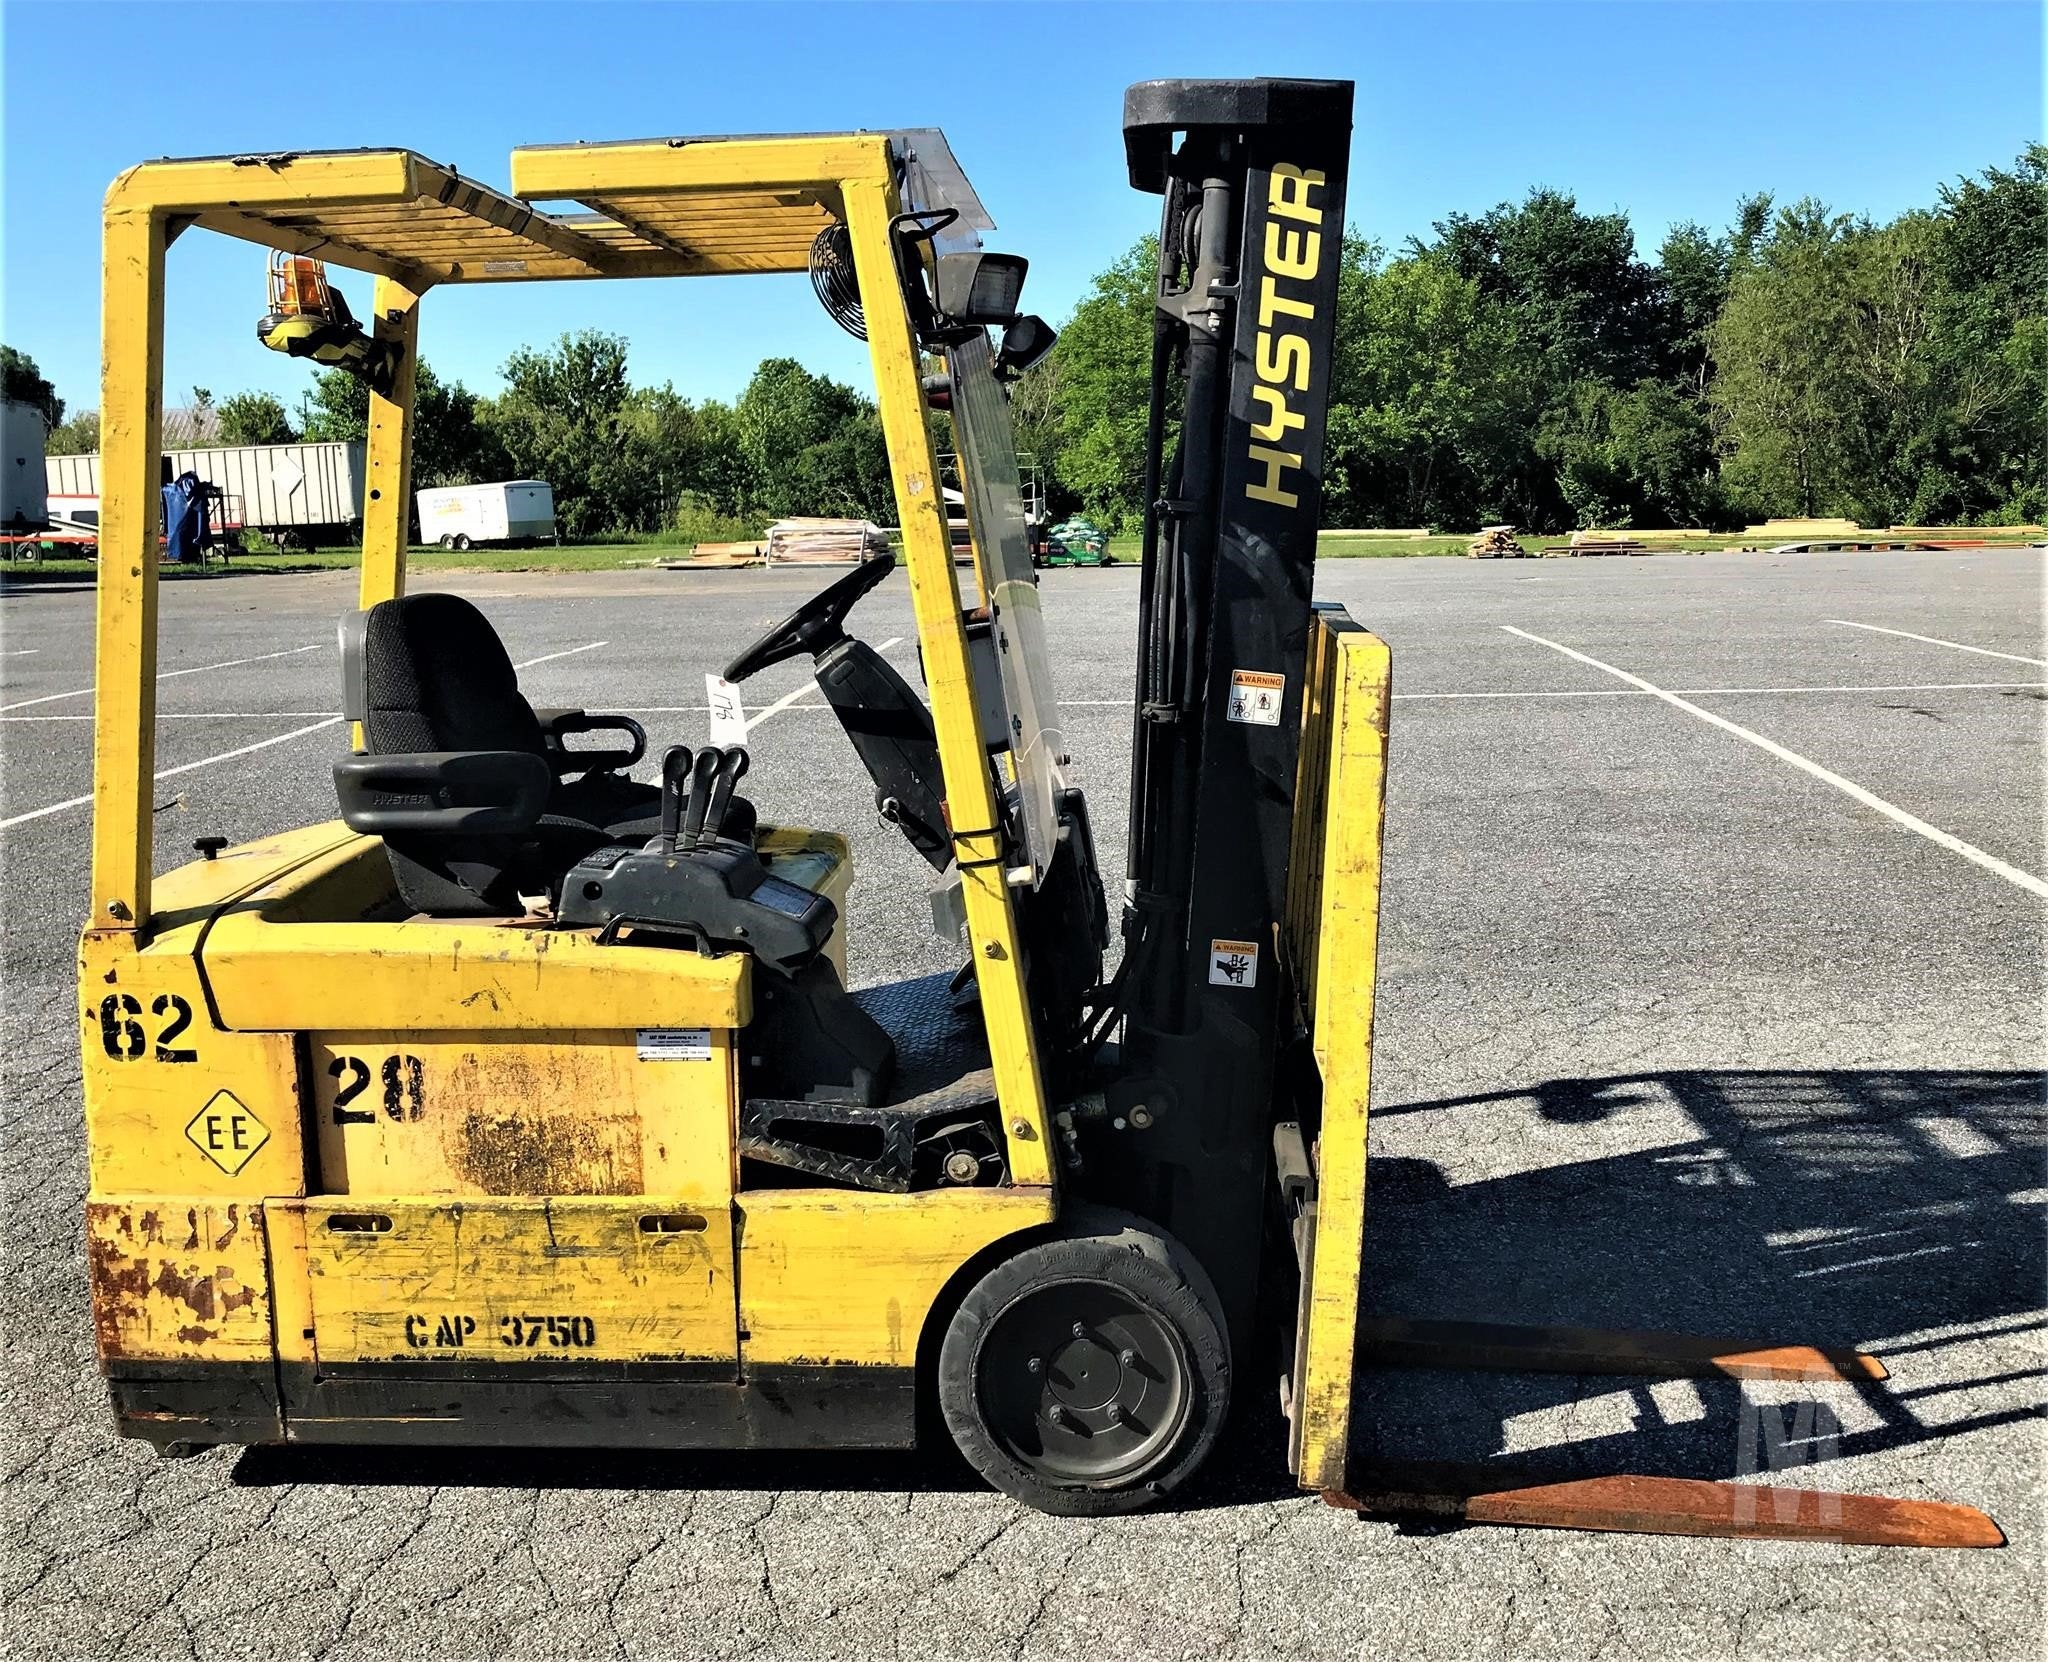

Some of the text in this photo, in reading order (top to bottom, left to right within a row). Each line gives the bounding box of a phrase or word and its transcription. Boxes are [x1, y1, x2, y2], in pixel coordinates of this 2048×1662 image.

[1245, 161, 1326, 509] HYSTER
[1244, 675, 1281, 686] WARNING
[373, 794, 429, 806] HYSTER
[100, 993, 198, 1063] 62
[328, 1054, 426, 1125] 28
[206, 1115, 249, 1150] EE
[405, 1314, 595, 1348] CAP 3750
